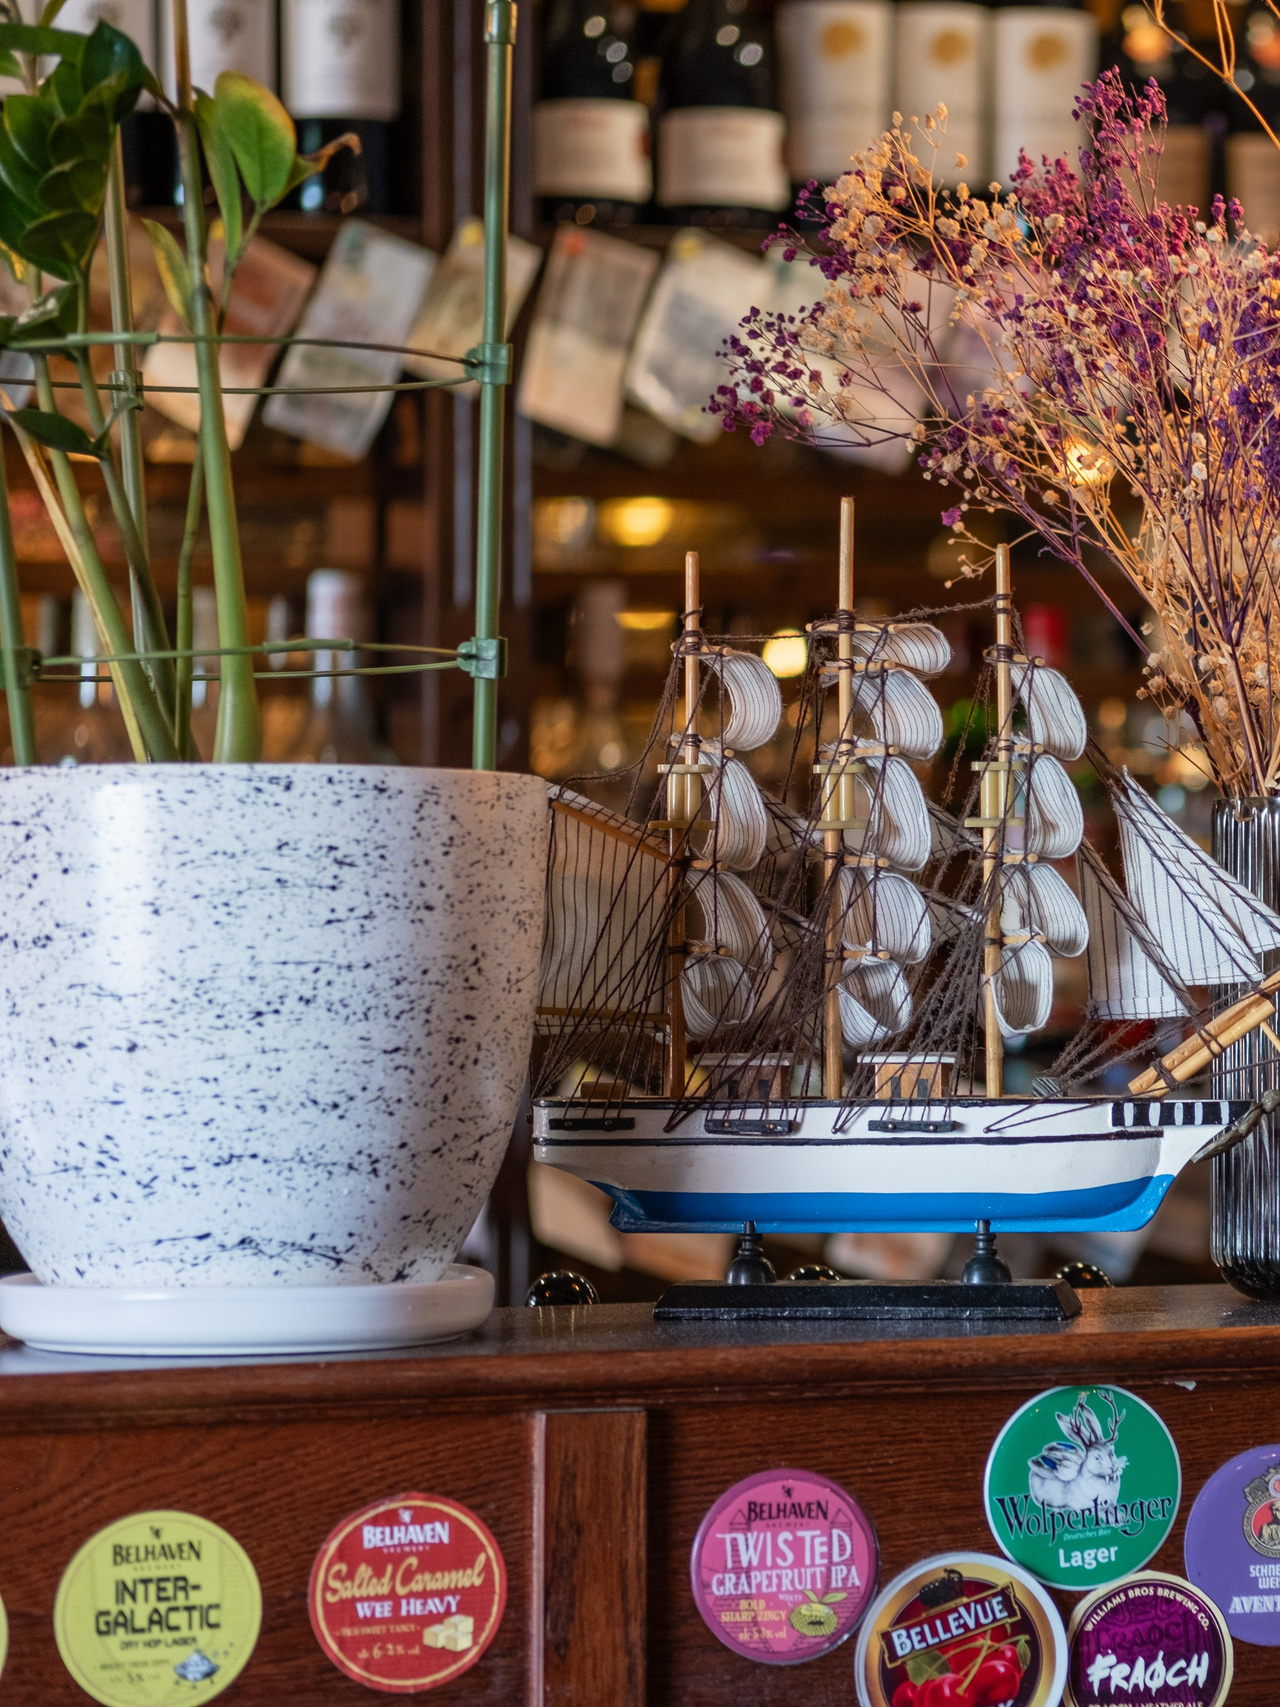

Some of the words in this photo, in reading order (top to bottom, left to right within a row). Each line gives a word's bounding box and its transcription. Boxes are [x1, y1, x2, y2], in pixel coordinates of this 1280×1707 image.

[748, 1500, 829, 1522] BELHAVEN
[994, 1494, 1174, 1546] Wolpertinger
[362, 1520, 449, 1549] BELHAVEN
[716, 1528, 852, 1569] TWISTED
[112, 1540, 201, 1567] BELHAVEN
[1058, 1546, 1118, 1570] Lager
[115, 1576, 201, 1605] INTER-
[325, 1562, 393, 1603] Salted
[395, 1552, 487, 1596] Caramel
[711, 1567, 825, 1596] GRAPEFRUIT
[830, 1565, 861, 1589] IPA
[95, 1604, 221, 1636] GALACTIC
[355, 1600, 393, 1619] WEE
[400, 1595, 461, 1617] HEAVY
[721, 1610, 755, 1623] SHARP
[1083, 1592, 1126, 1632] WILLIAMS
[1128, 1586, 1154, 1598] BROS
[1157, 1587, 1198, 1614] BREWING
[1197, 1612, 1210, 1631] CO.
